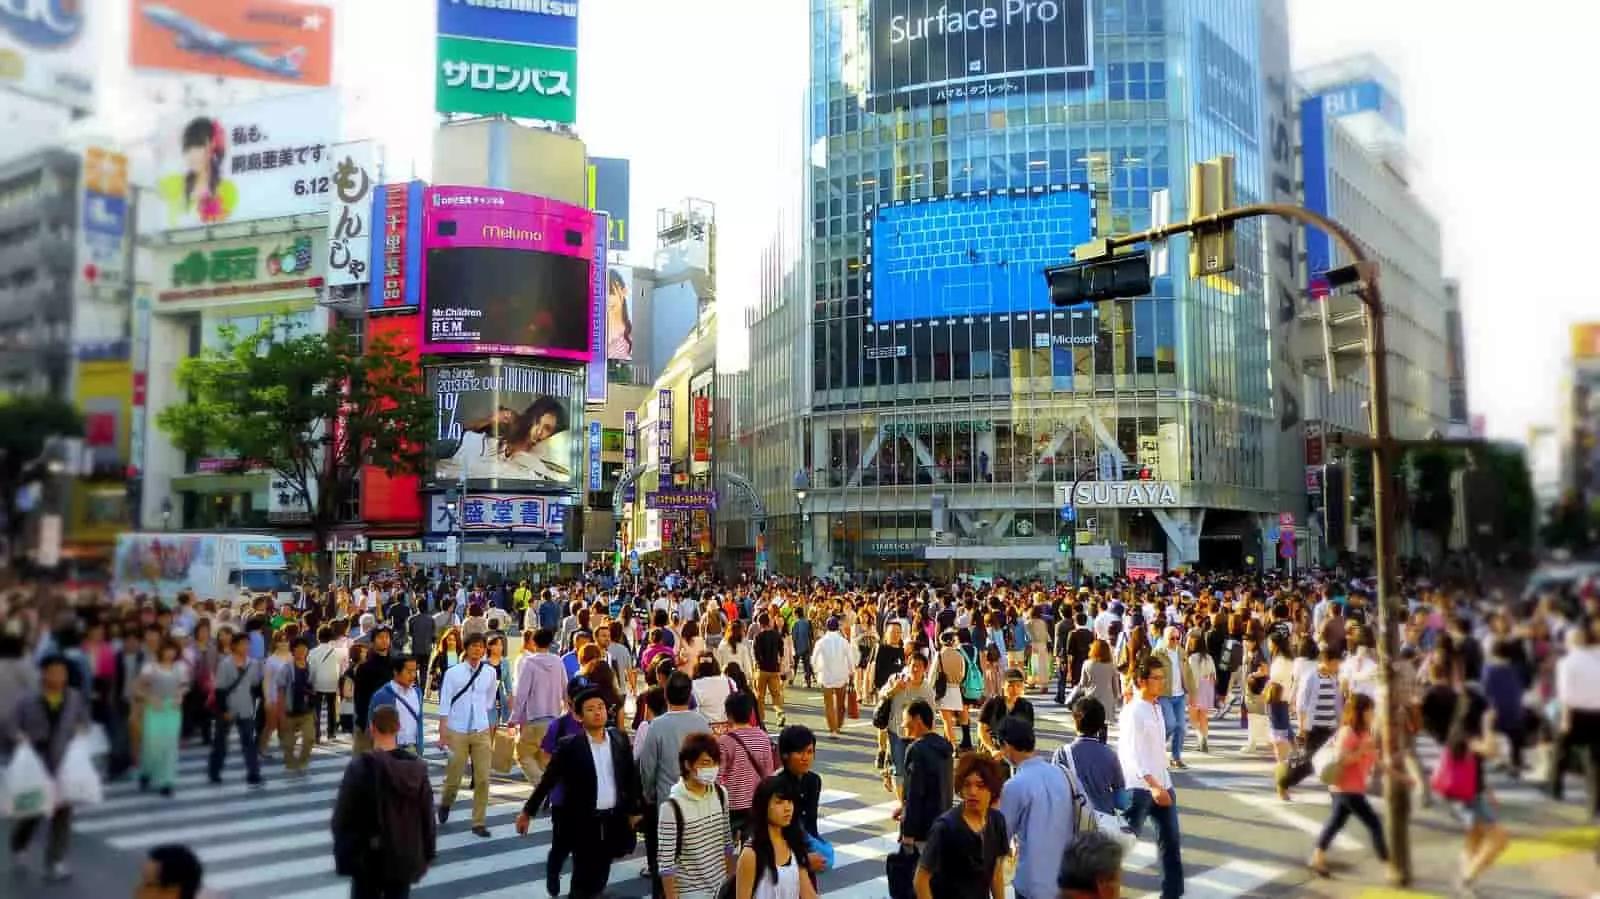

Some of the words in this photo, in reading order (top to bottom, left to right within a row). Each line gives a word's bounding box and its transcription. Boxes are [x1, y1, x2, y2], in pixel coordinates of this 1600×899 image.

[890, 6, 997, 43] Surface
[1005, 0, 1058, 25] Pro
[442, 61, 572, 97] サロンパス
[294, 177, 328, 196] 6.12
[329, 155, 369, 280] もんじゃ
[431, 307, 482, 317] Mr.Children
[432, 321, 463, 333] REM
[1052, 334, 1099, 346] Microsoft
[1060, 484, 1176, 505] TSUTAYA
[437, 499, 566, 535] 大盛堂書店
